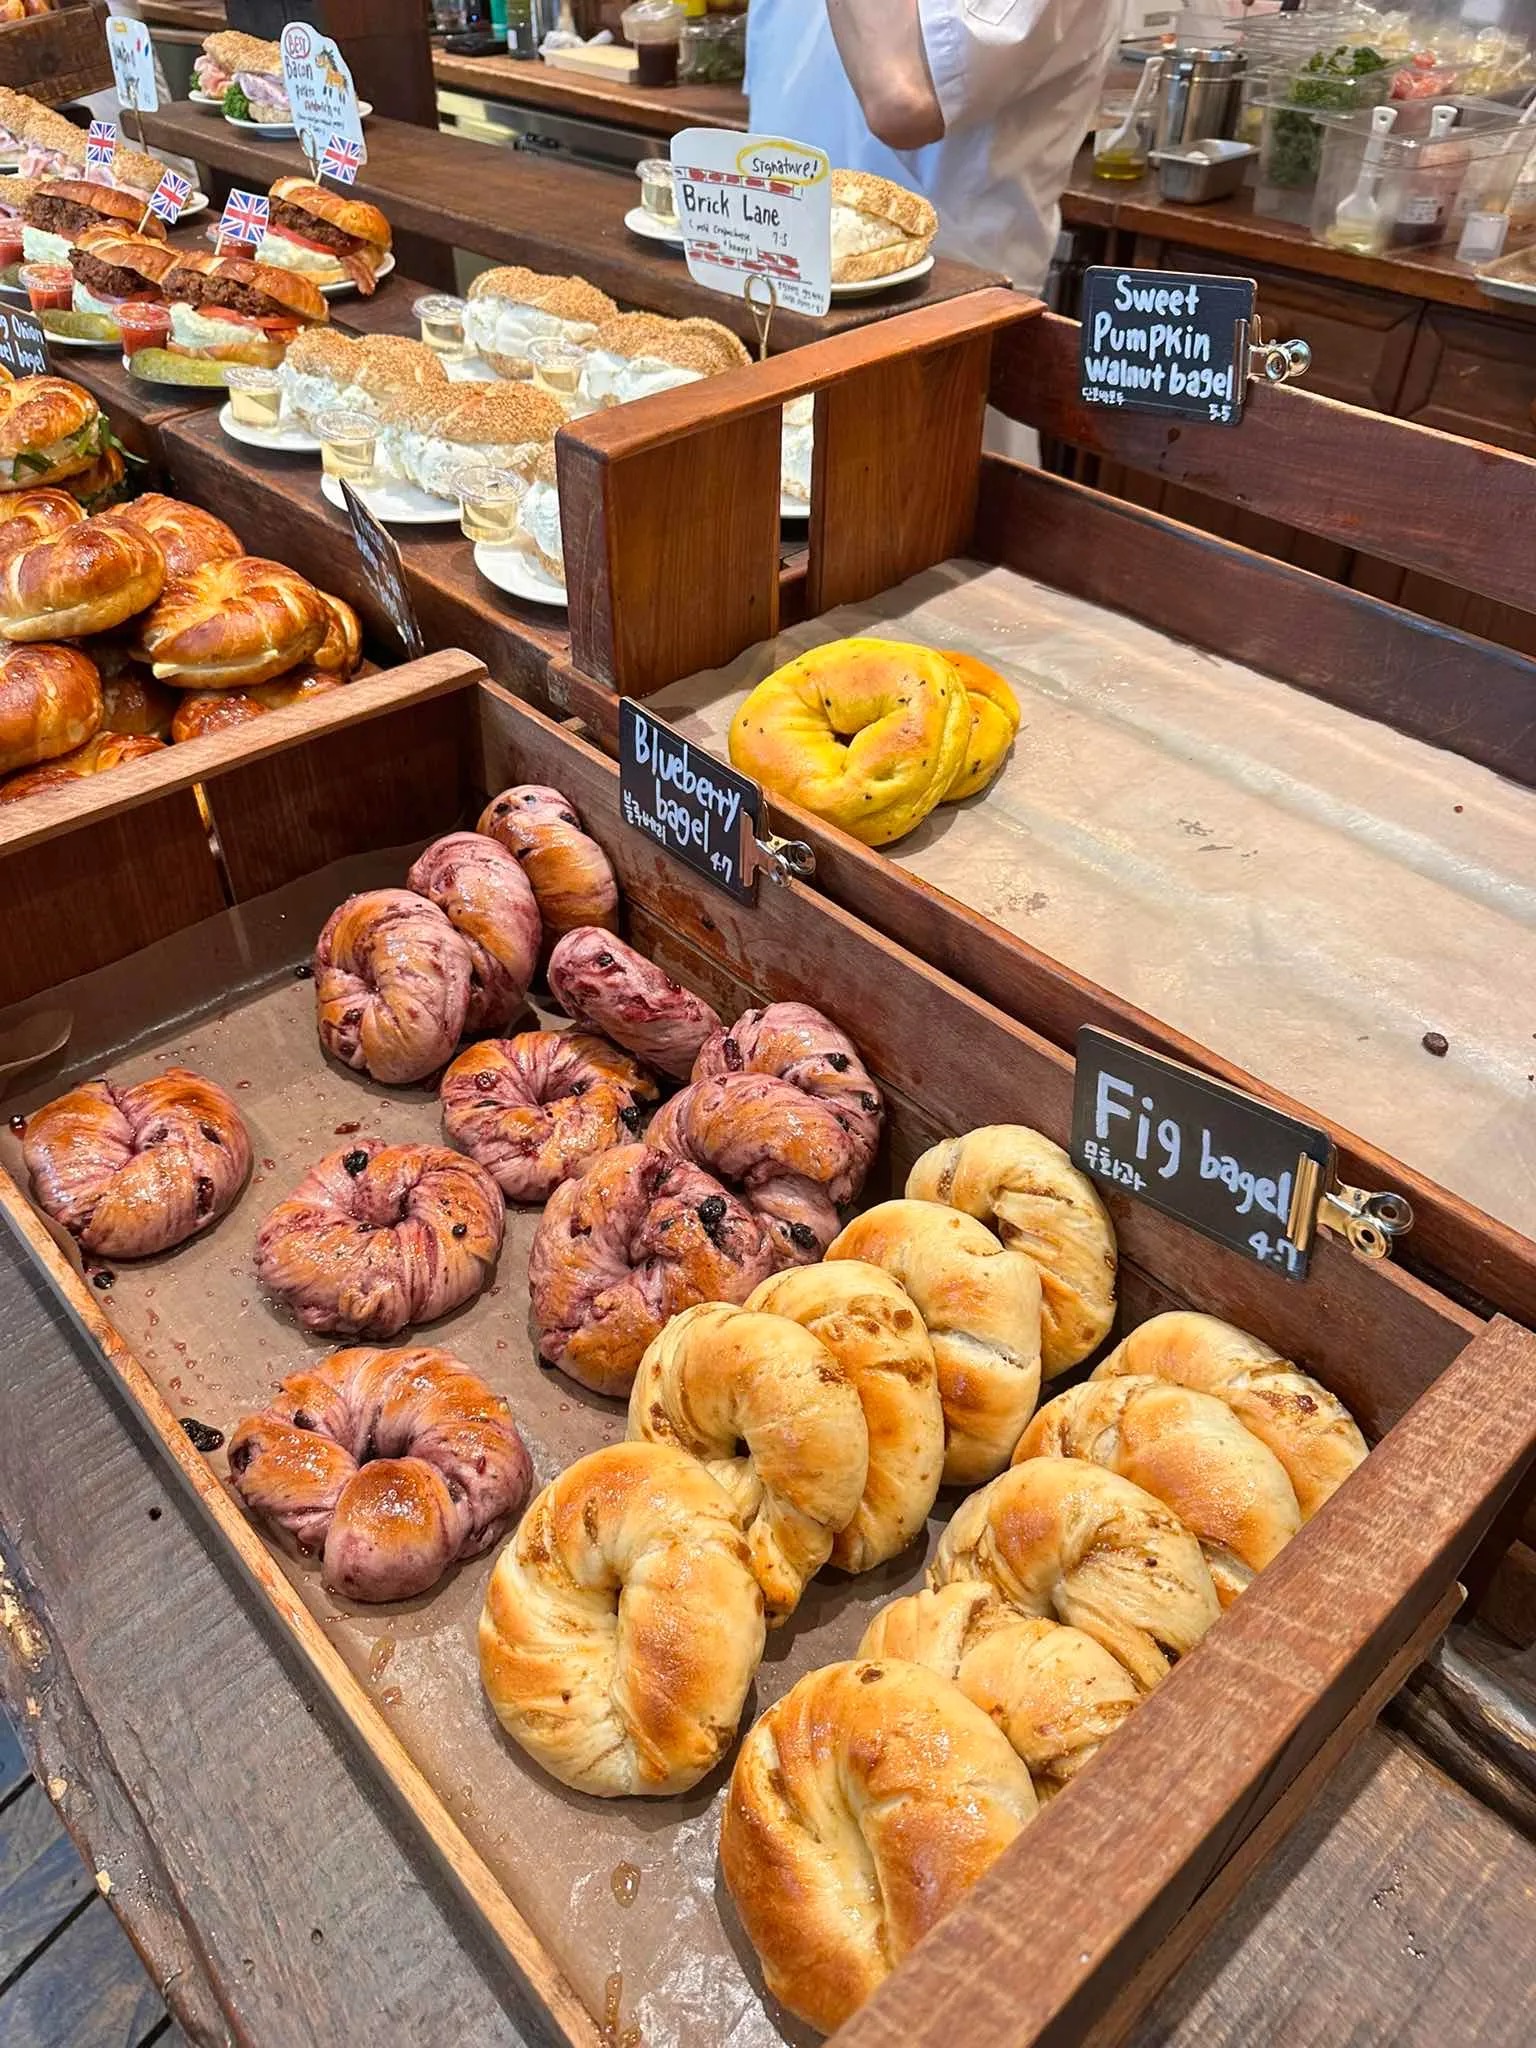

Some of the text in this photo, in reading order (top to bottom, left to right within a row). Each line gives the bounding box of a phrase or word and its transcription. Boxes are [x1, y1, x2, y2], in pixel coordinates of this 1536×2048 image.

[285, 56, 314, 80] Bacon
[682, 184, 781, 226] Brick Lane
[1114, 274, 1200, 316] Sweet
[15, 340, 47, 375] bagel
[1169, 362, 1234, 401] bagel
[635, 713, 740, 833] Blueberry
[656, 779, 710, 853] bagel
[1083, 1139, 1148, 1191] 무화과
[1096, 1070, 1292, 1225] Fig bagel
